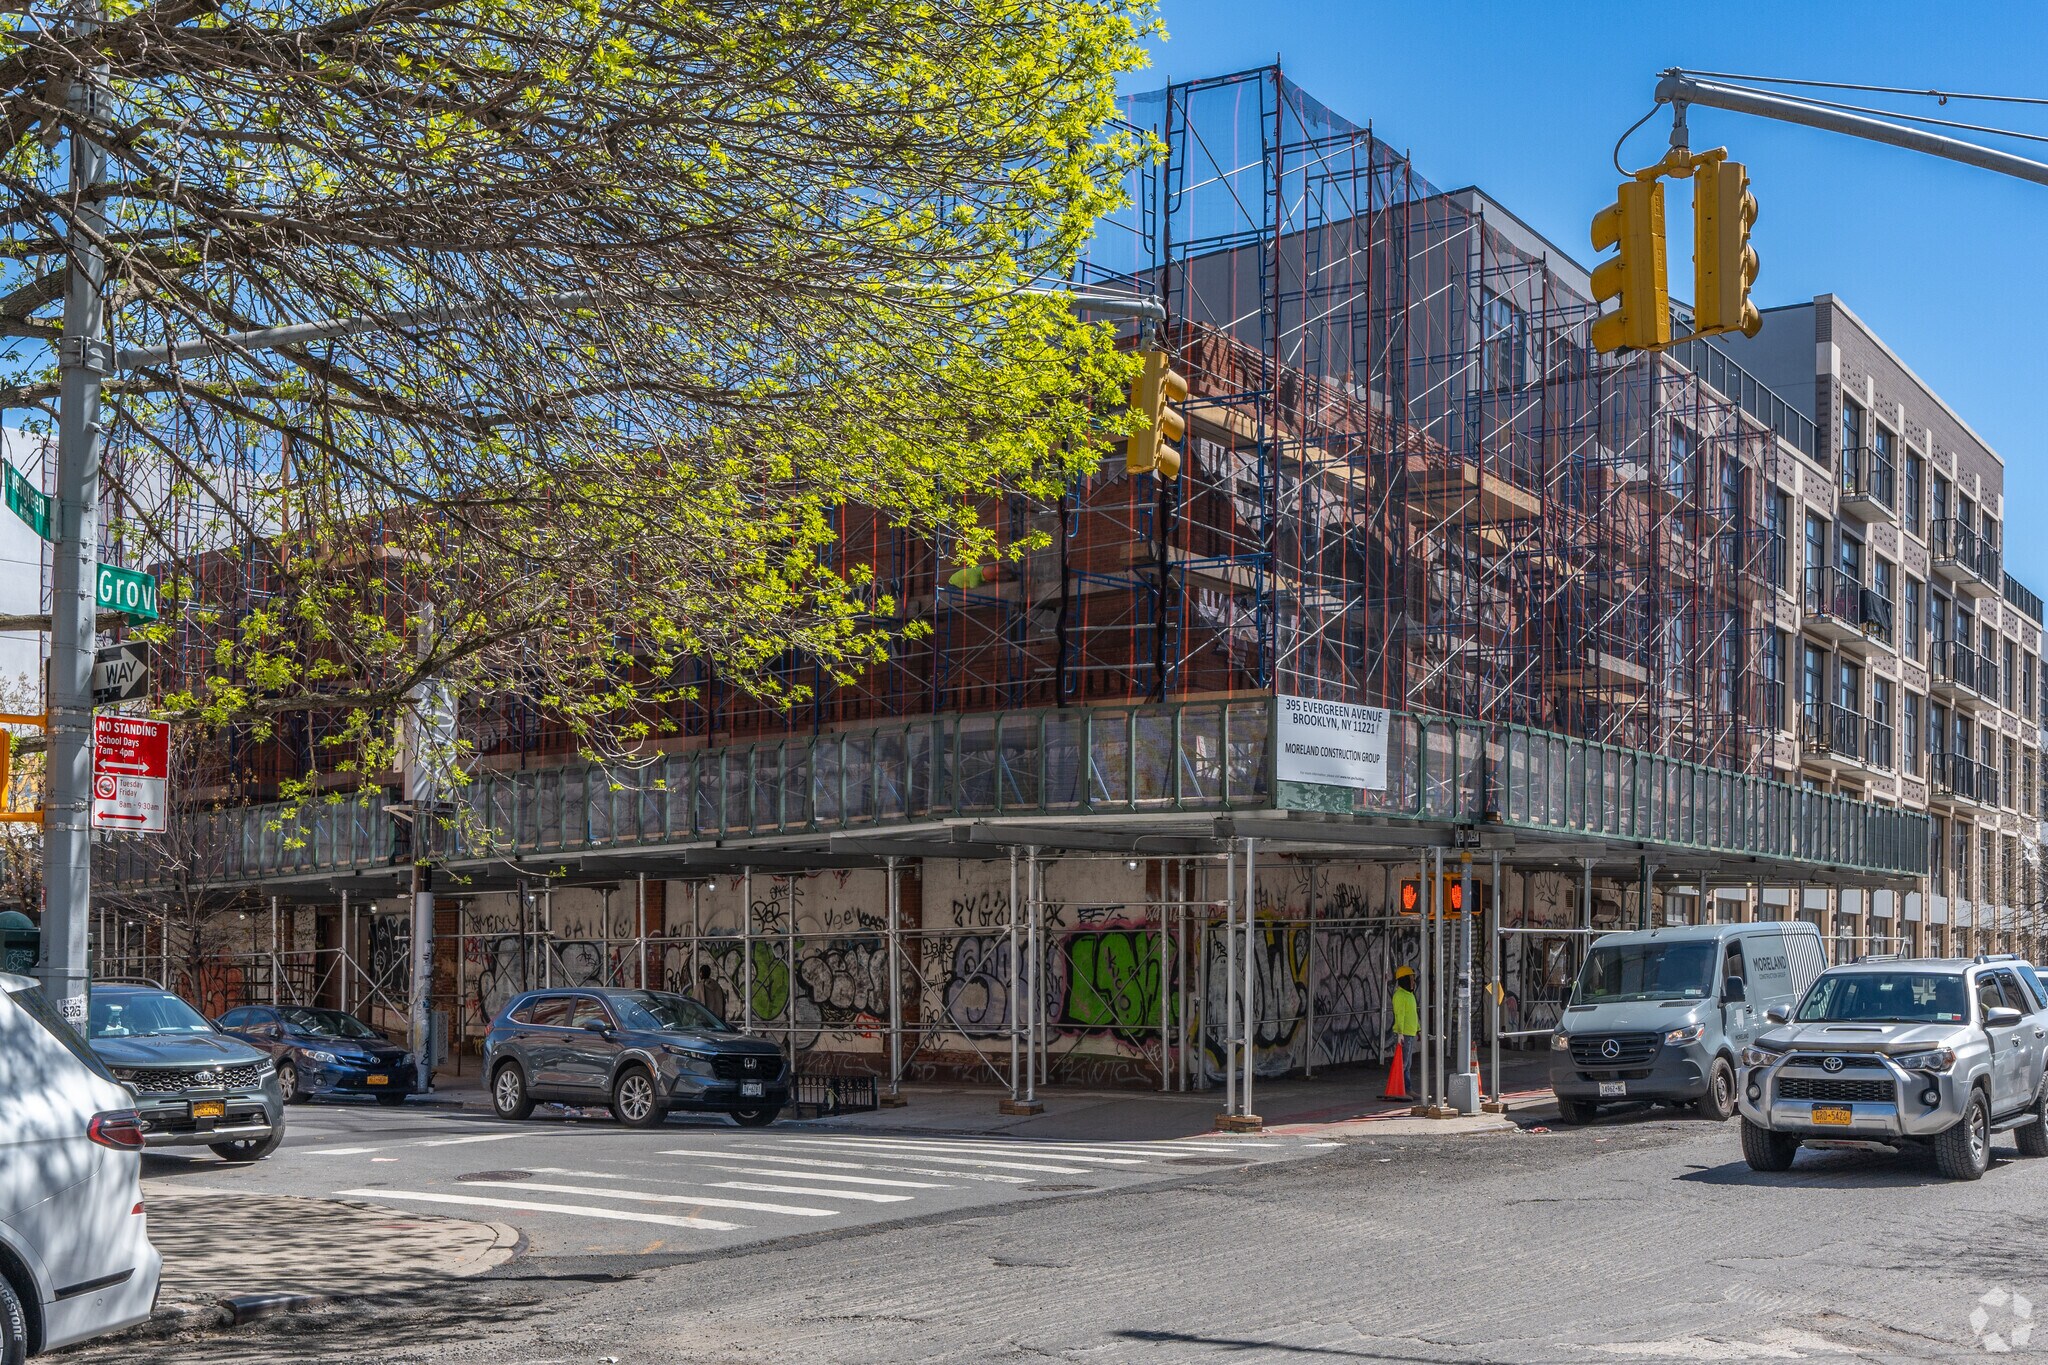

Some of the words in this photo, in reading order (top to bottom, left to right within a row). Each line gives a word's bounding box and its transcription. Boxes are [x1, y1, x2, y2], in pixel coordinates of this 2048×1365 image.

[8, 463, 45, 516] Evergreen
[106, 660, 137, 685] WAY
[1285, 699, 1301, 711] 395
[1303, 701, 1350, 718] EVERGREEN
[1351, 708, 1383, 722] AVENUE
[98, 720, 112, 732] NO
[114, 723, 158, 737] STANDING
[1293, 713, 1340, 731] BROOKLYN,
[1341, 719, 1352, 730] NY
[1354, 720, 1375, 734] 11221
[98, 734, 122, 746] School
[123, 737, 140, 749] Days
[98, 746, 113, 755] 7am
[119, 748, 135, 757] 4pm
[1285, 743, 1320, 757] MORELAND
[1320, 747, 1361, 762] CONSTRUCTION
[1361, 752, 1381, 764] GROUP
[120, 780, 144, 790] Tuesday
[119, 788, 137, 798] Friday
[119, 800, 132, 809] 8am
[137, 801, 160, 811] 9:30am
[1752, 956, 1787, 971] MORELAND
[197, 1073, 213, 1081] KIA
